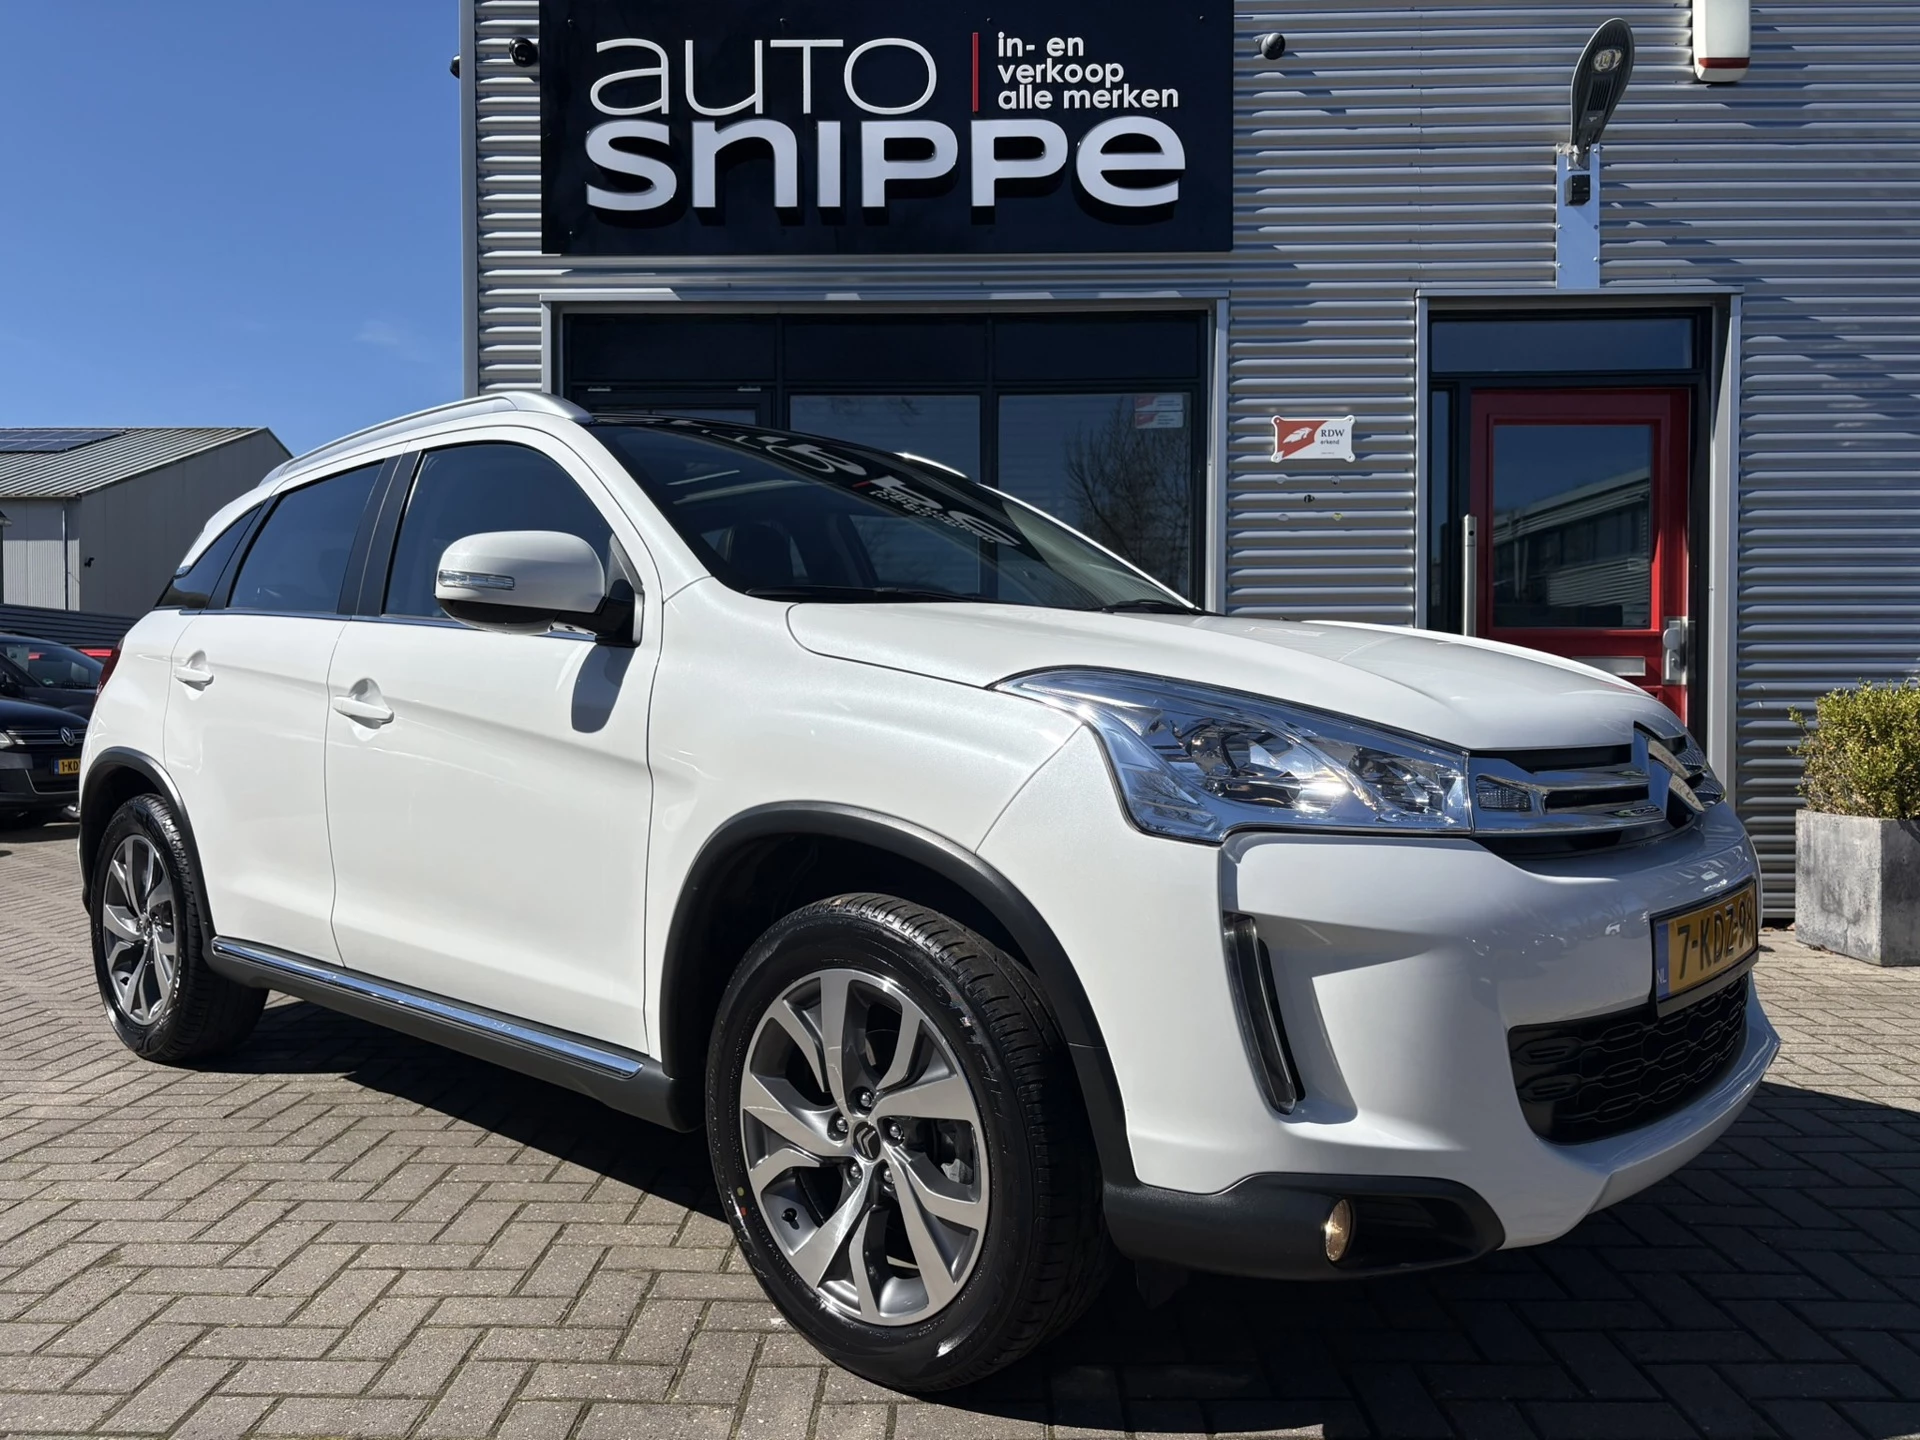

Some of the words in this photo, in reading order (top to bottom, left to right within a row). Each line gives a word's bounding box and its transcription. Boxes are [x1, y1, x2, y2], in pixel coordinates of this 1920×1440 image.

[997, 31, 1036, 57] in-
[1046, 37, 1084, 57] en
[997, 57, 1125, 89] verkoop
[997, 84, 1053, 110] alle
[1063, 83, 1179, 109] merken
[1320, 429, 1345, 438] RDW
